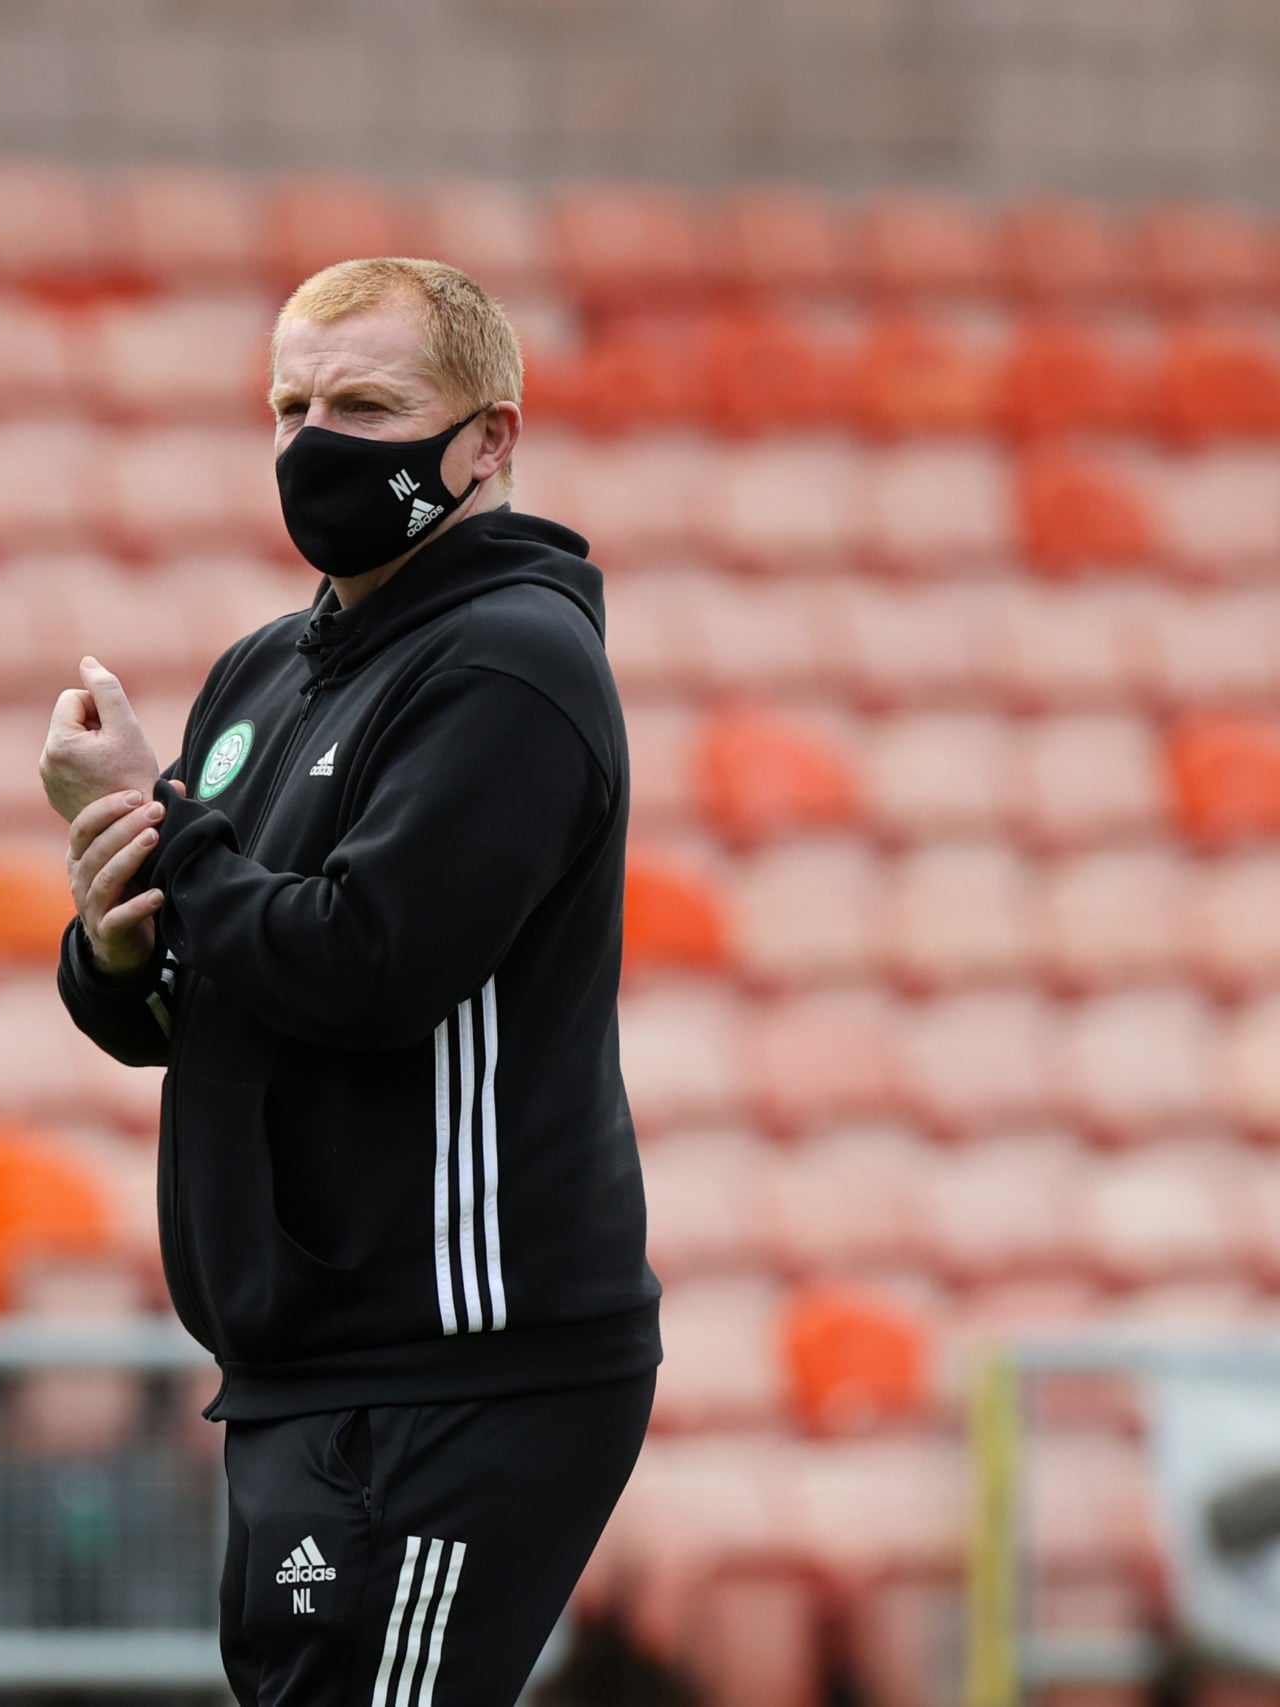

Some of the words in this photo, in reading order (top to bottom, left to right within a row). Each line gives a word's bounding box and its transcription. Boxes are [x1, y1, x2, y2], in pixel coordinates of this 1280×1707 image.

[388, 468, 421, 501] NL
[406, 504, 444, 537] adidas
[276, 1565, 336, 1584] adidas
[293, 1588, 316, 1614] NL
